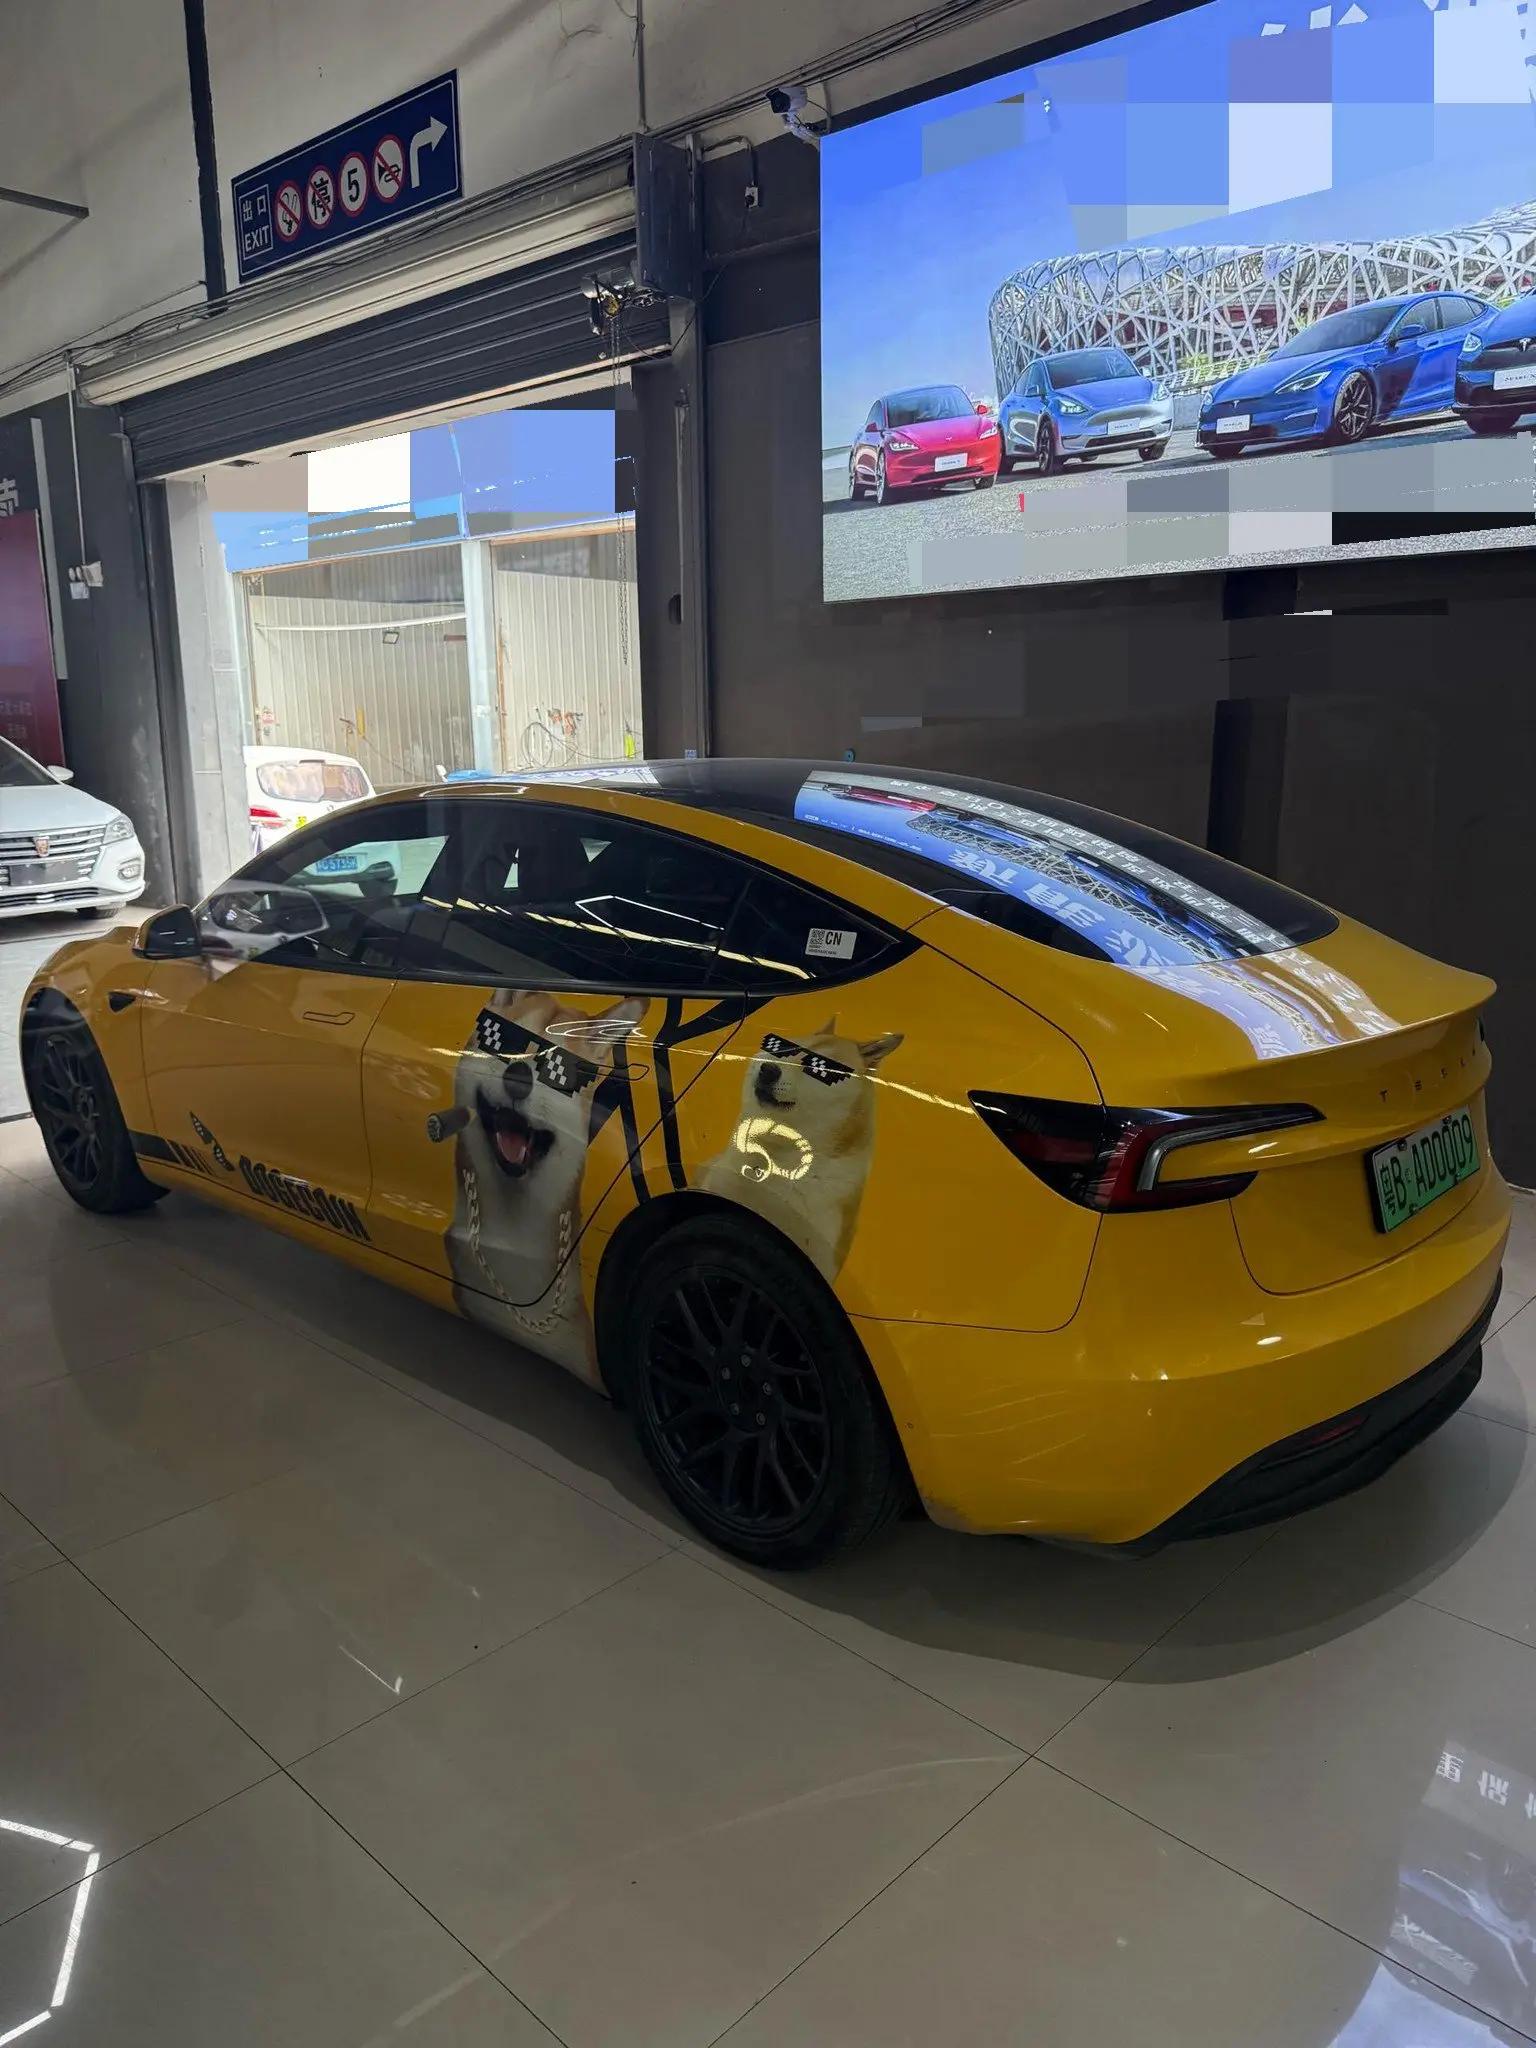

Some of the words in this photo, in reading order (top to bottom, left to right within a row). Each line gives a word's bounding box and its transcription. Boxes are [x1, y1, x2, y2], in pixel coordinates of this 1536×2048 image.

[347, 168, 360, 202] 5
[243, 196, 266, 221] 出口
[245, 225, 269, 252] EXIT
[825, 931, 843, 946] CN
[1379, 1046, 1476, 1103] TESL
